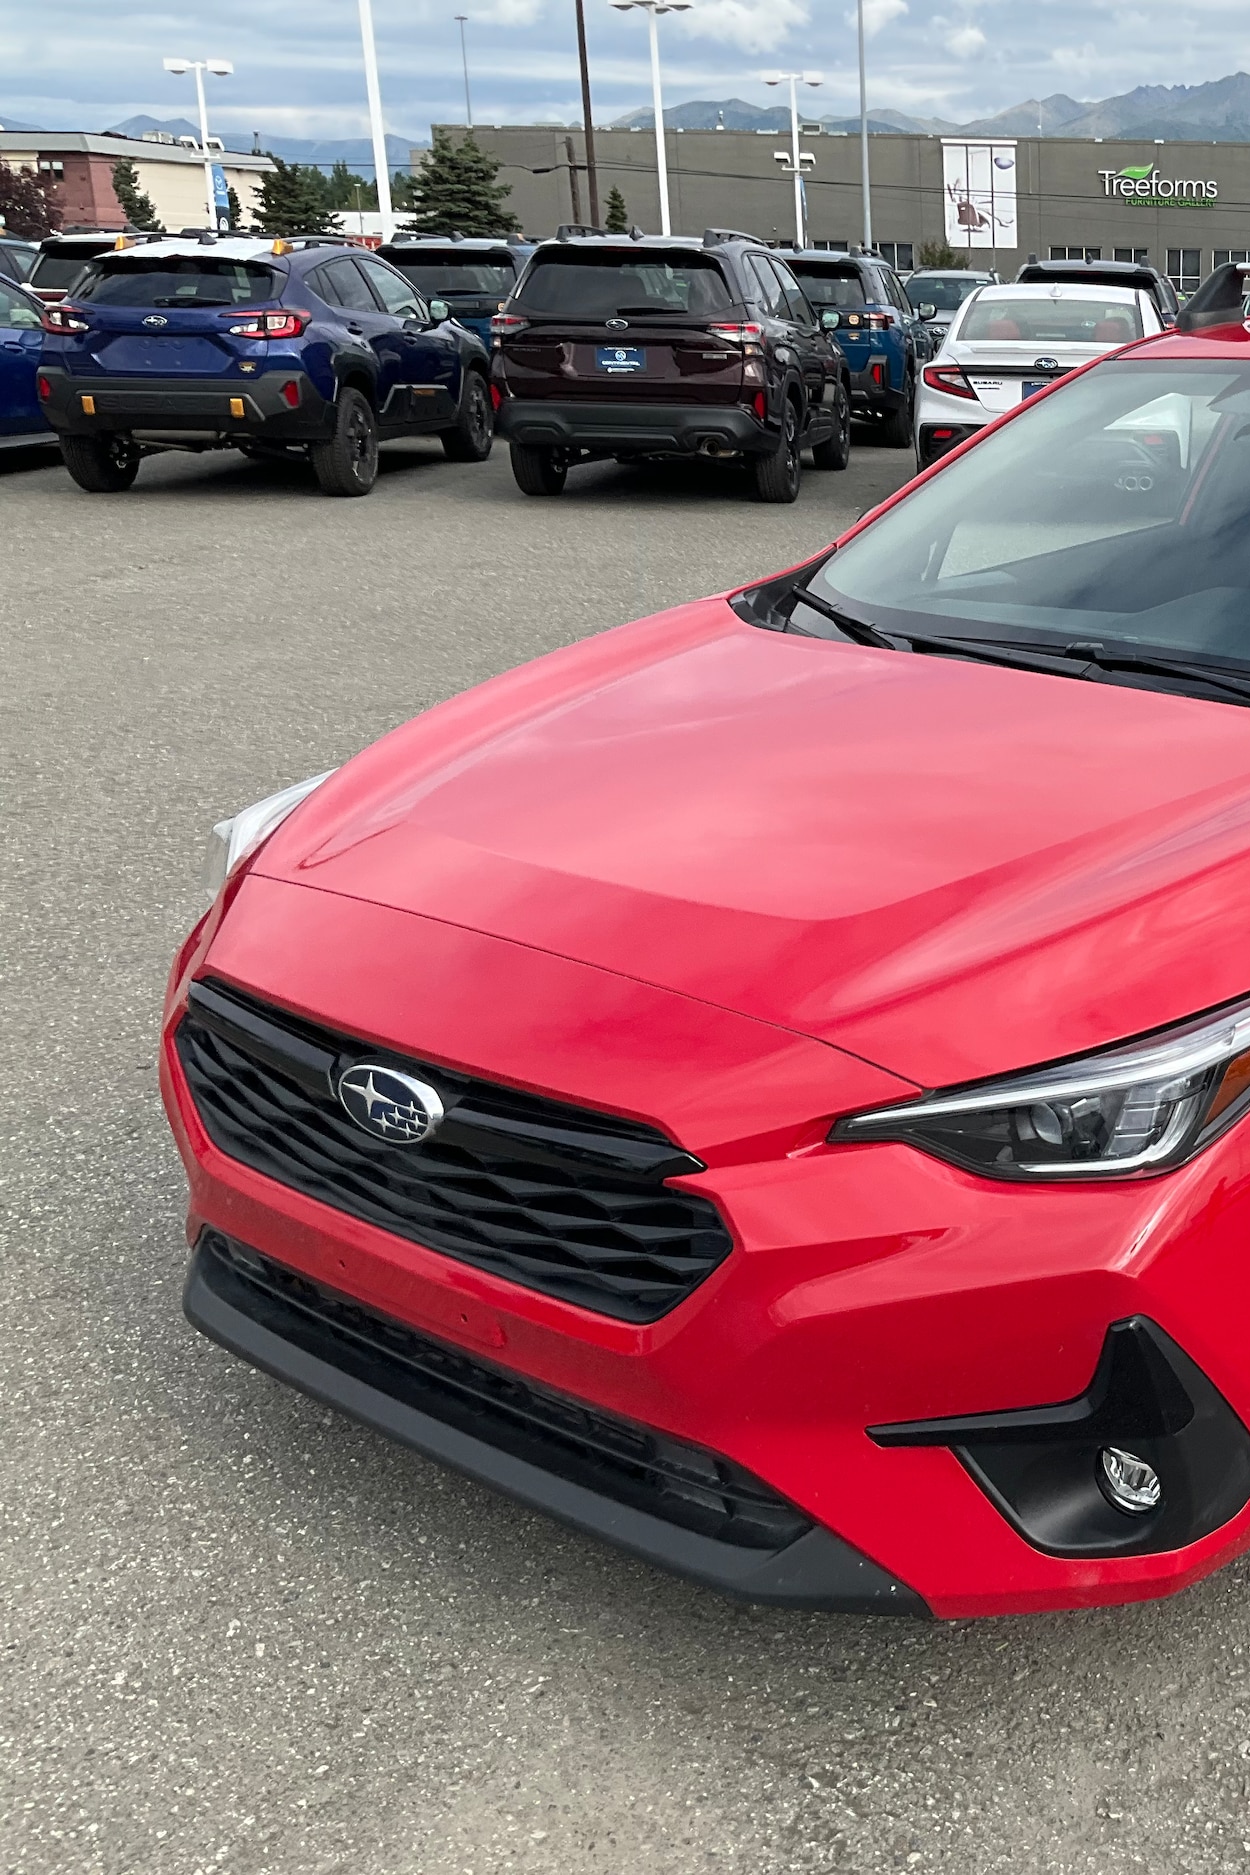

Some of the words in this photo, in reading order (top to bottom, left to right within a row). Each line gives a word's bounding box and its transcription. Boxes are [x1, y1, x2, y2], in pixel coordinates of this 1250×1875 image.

[1098, 169, 1218, 198] Treeforms
[1125, 197, 1175, 206] FURNITURE
[1177, 198, 1217, 208] GALLERY
